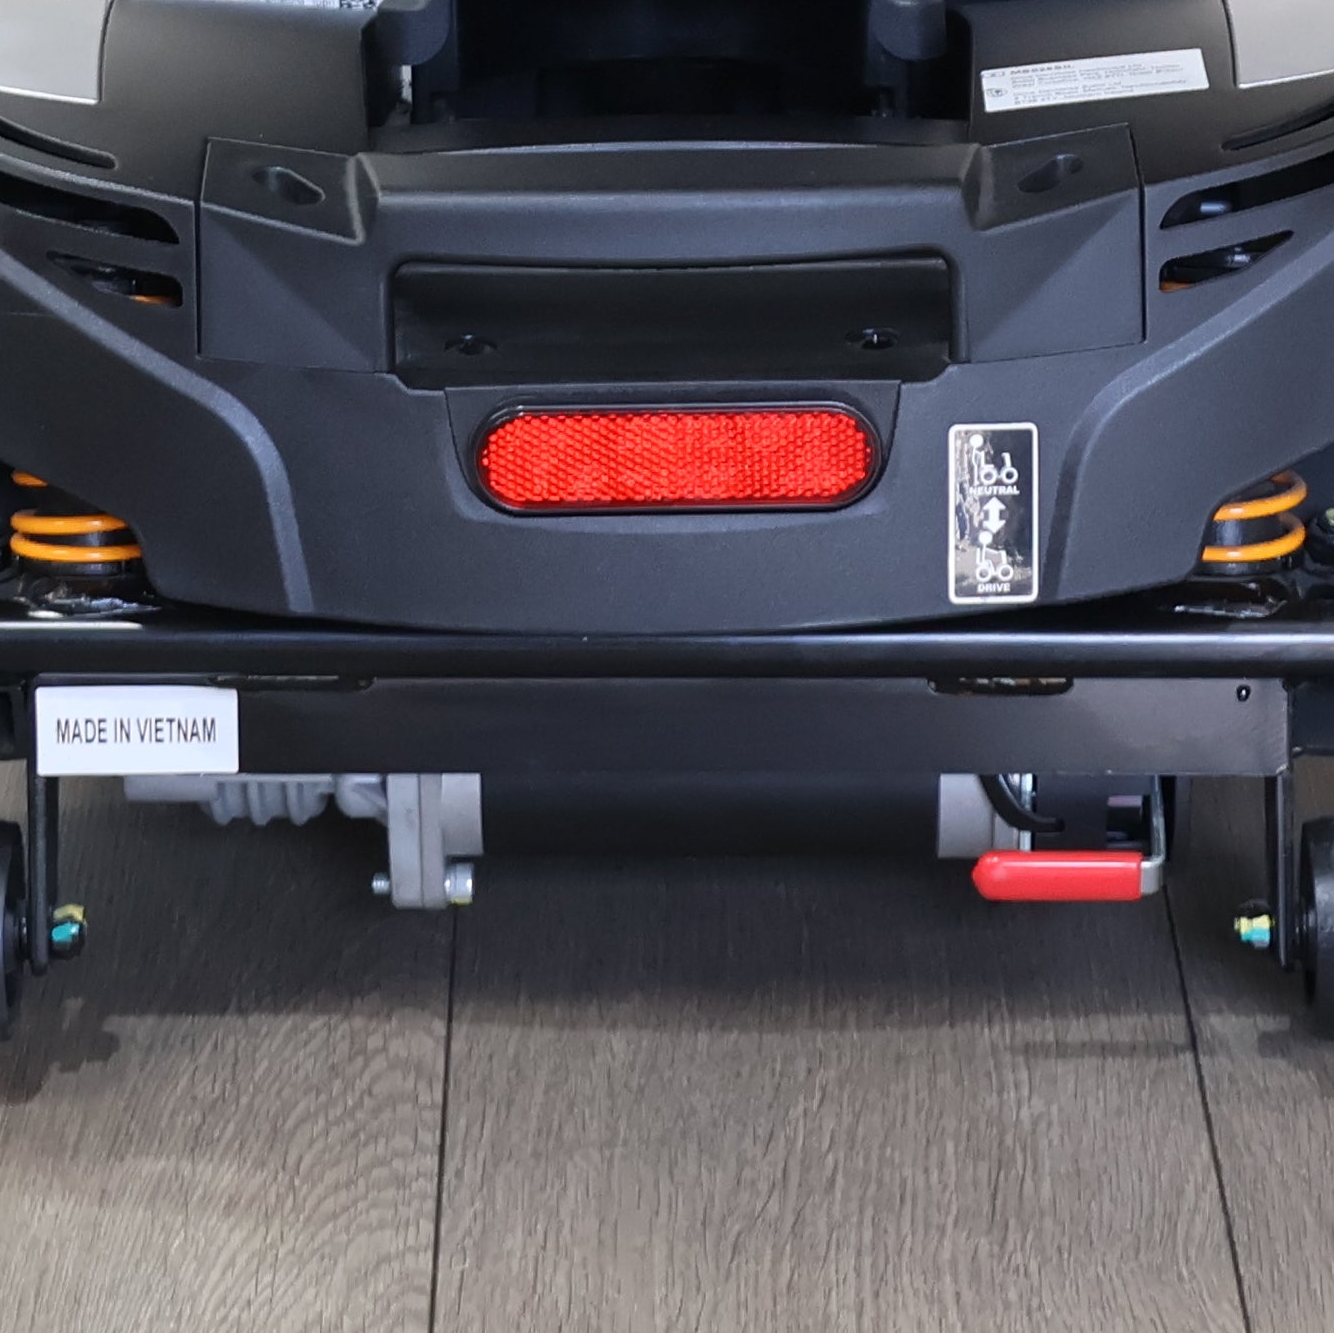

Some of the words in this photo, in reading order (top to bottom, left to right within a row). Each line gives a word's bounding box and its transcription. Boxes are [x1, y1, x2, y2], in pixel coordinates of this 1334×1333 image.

[969, 485, 1020, 496] NEUTRAL
[977, 582, 1012, 593] DRIVE
[56, 717, 108, 744] MADE
[114, 717, 131, 743] IN
[137, 716, 216, 743] VIETNAM
